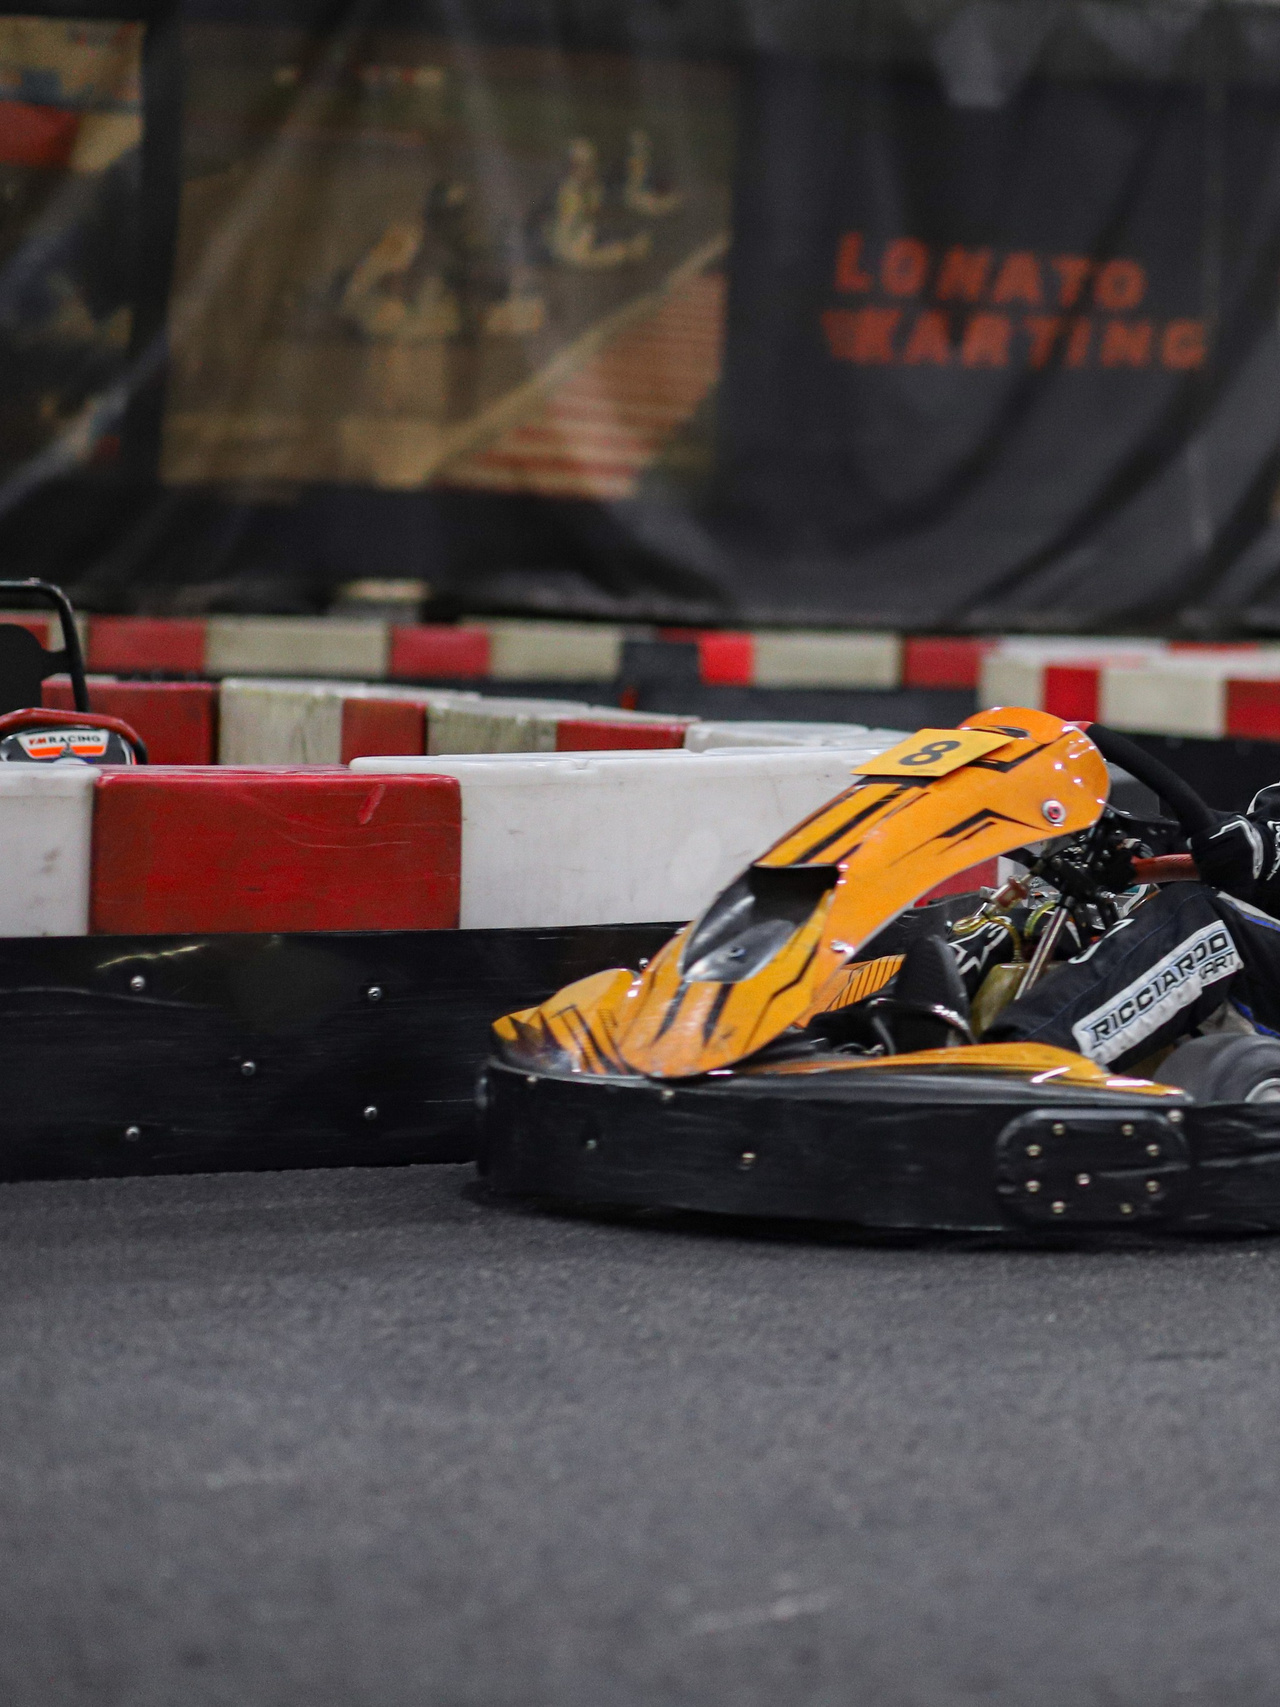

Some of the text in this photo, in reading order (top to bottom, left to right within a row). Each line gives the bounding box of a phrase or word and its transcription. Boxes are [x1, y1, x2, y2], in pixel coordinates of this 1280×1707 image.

[833, 231, 1149, 311] LONATO
[820, 307, 1208, 371] KARTING
[48, 735, 102, 744] RACING
[898, 740, 962, 766] 8
[1090, 931, 1231, 1043] RICCIARDO
